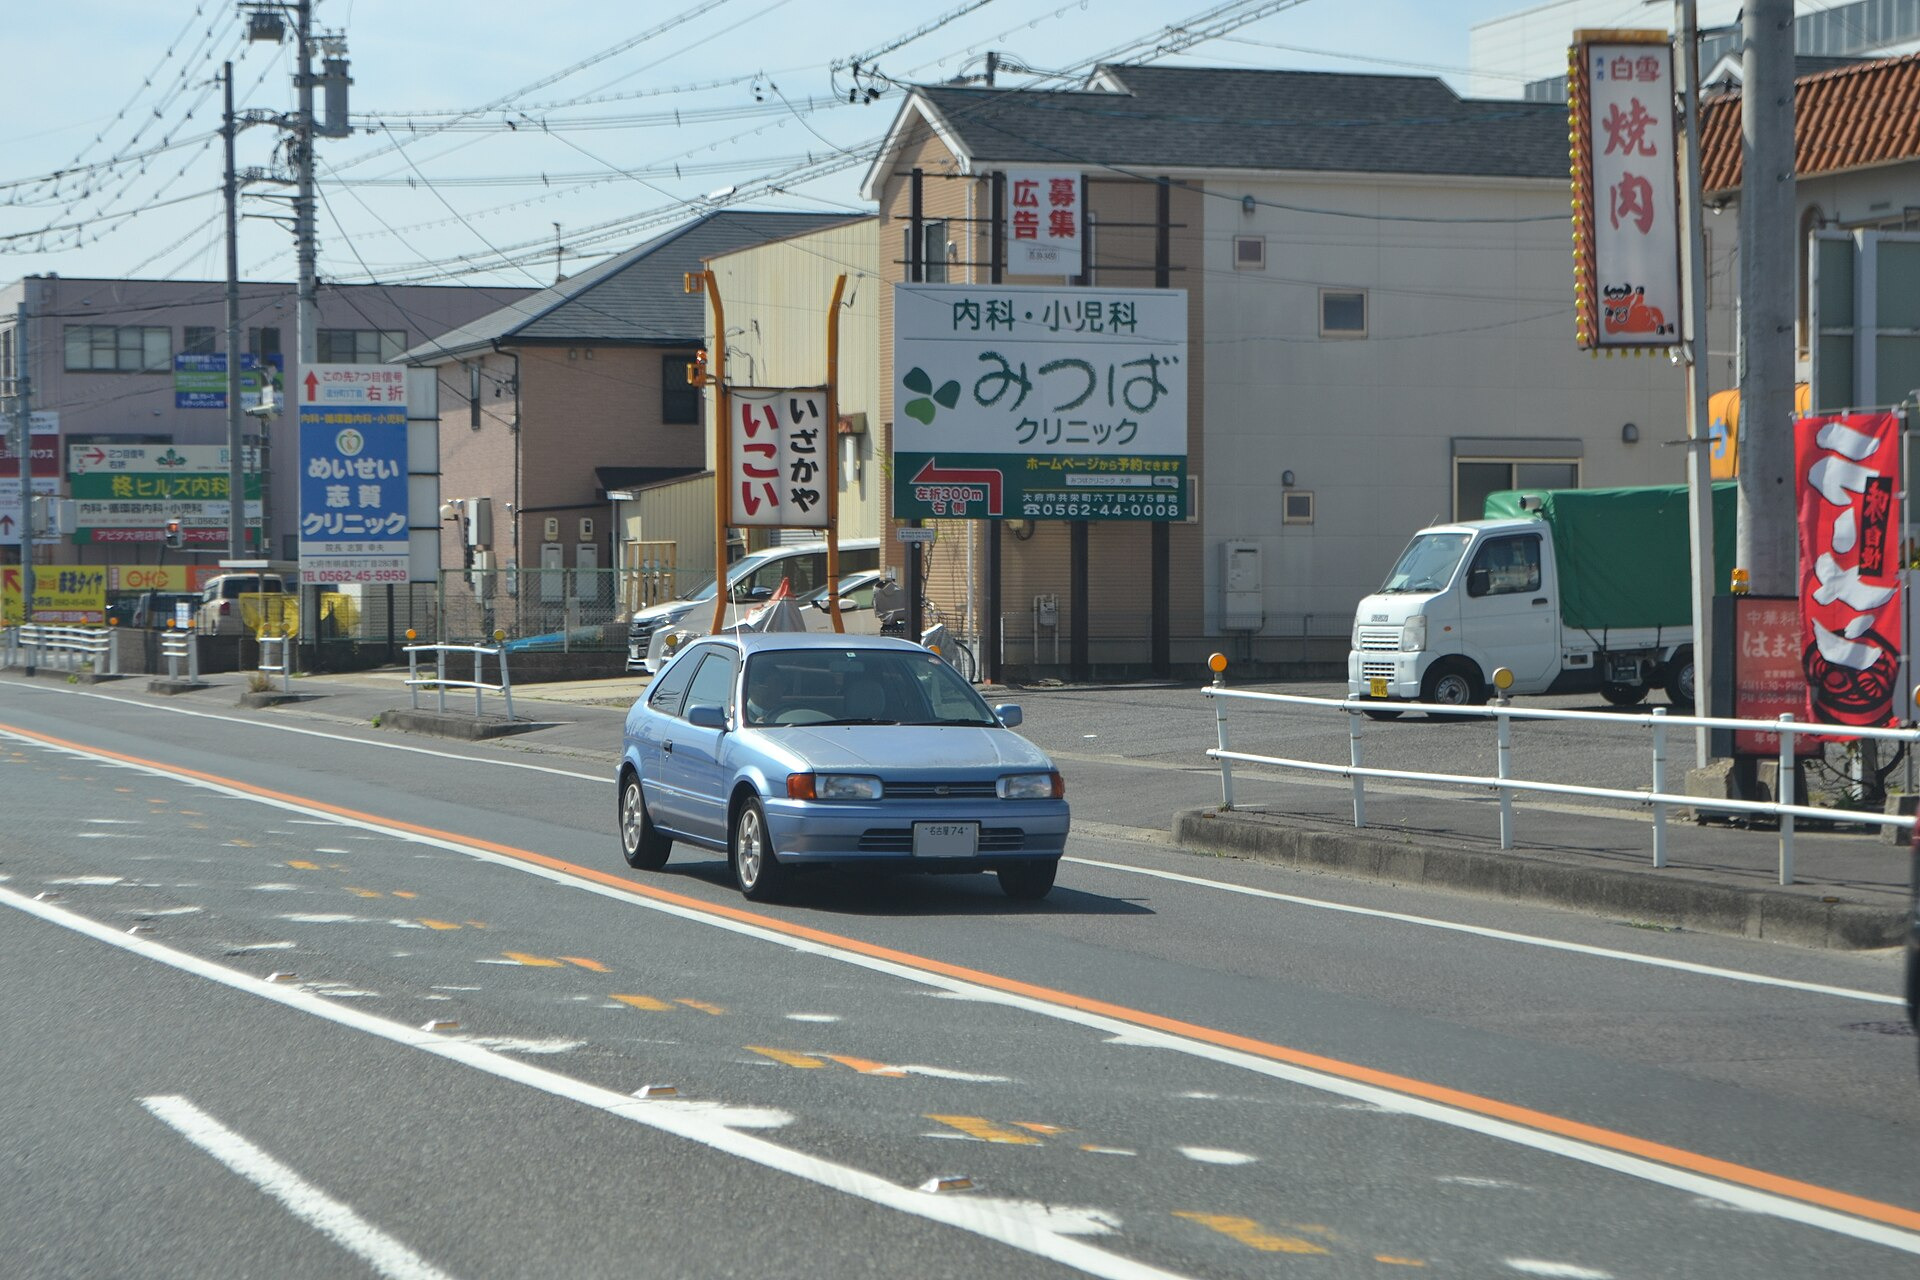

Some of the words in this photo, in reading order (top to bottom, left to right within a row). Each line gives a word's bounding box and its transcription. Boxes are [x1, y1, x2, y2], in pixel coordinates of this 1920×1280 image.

[1610, 56, 1661, 83] 白雪
[1602, 97, 1659, 236] 焼肉
[1012, 179, 1039, 240] 広告
[1048, 178, 1076, 238] 募集
[953, 299, 1138, 333] 内科・小児科
[367, 385, 404, 402] 右折
[973, 351, 1180, 414] みつば
[1015, 417, 1138, 446] クリニック
[742, 403, 780, 516] いこい
[789, 398, 820, 513] いざかや
[1026, 458, 1179, 472] ホームページから予約できます
[308, 458, 399, 479] めいせい
[112, 475, 230, 498] 柊ヒルズ内科
[325, 484, 382, 509] 志賀
[915, 487, 984, 502] 左折300m
[932, 501, 968, 516] 右側
[1022, 494, 1178, 503] 大府市共栄町六丁目475番地
[1043, 505, 1179, 516] 0562-44-0008
[303, 513, 406, 535] クリニック
[302, 570, 316, 582] TEL
[319, 570, 407, 582] 0562-45-5959
[930, 826, 948, 835] 名古屋
[951, 826, 964, 835] 74
